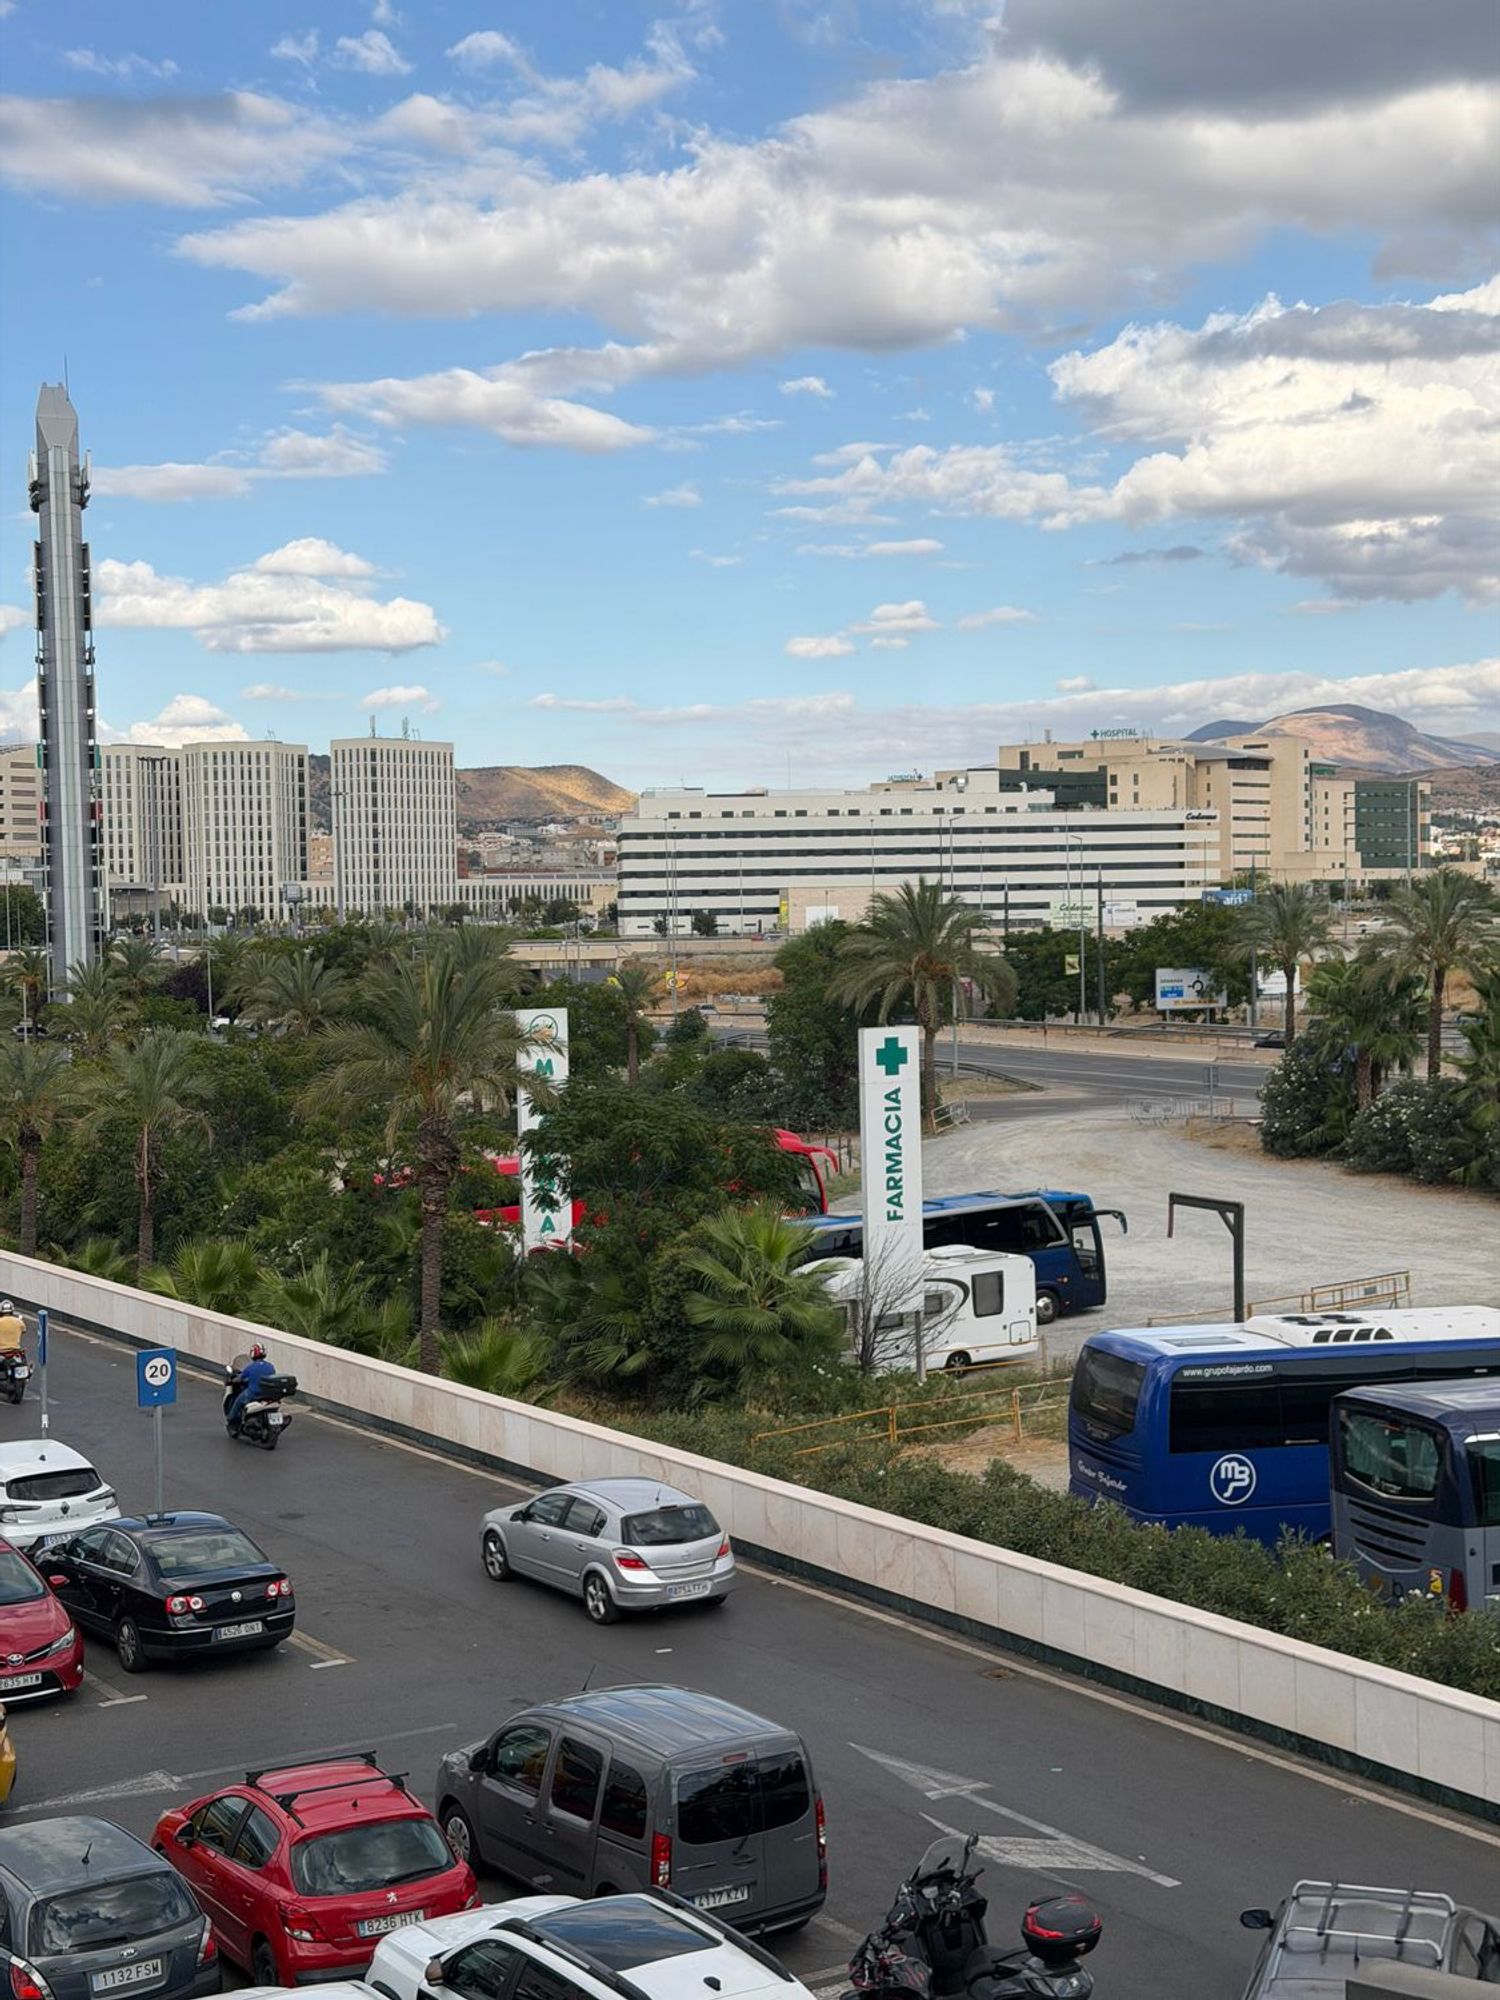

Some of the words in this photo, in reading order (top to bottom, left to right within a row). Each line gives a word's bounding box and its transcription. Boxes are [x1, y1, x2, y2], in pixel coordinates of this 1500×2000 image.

[1100, 728, 1138, 738] HOSPITAL
[884, 1086, 904, 1222] FARMACIA
[149, 1364, 169, 1379] 20
[367, 1916, 397, 1933] 8236
[400, 1911, 421, 1927] HTK
[102, 1968, 133, 1987] 1132
